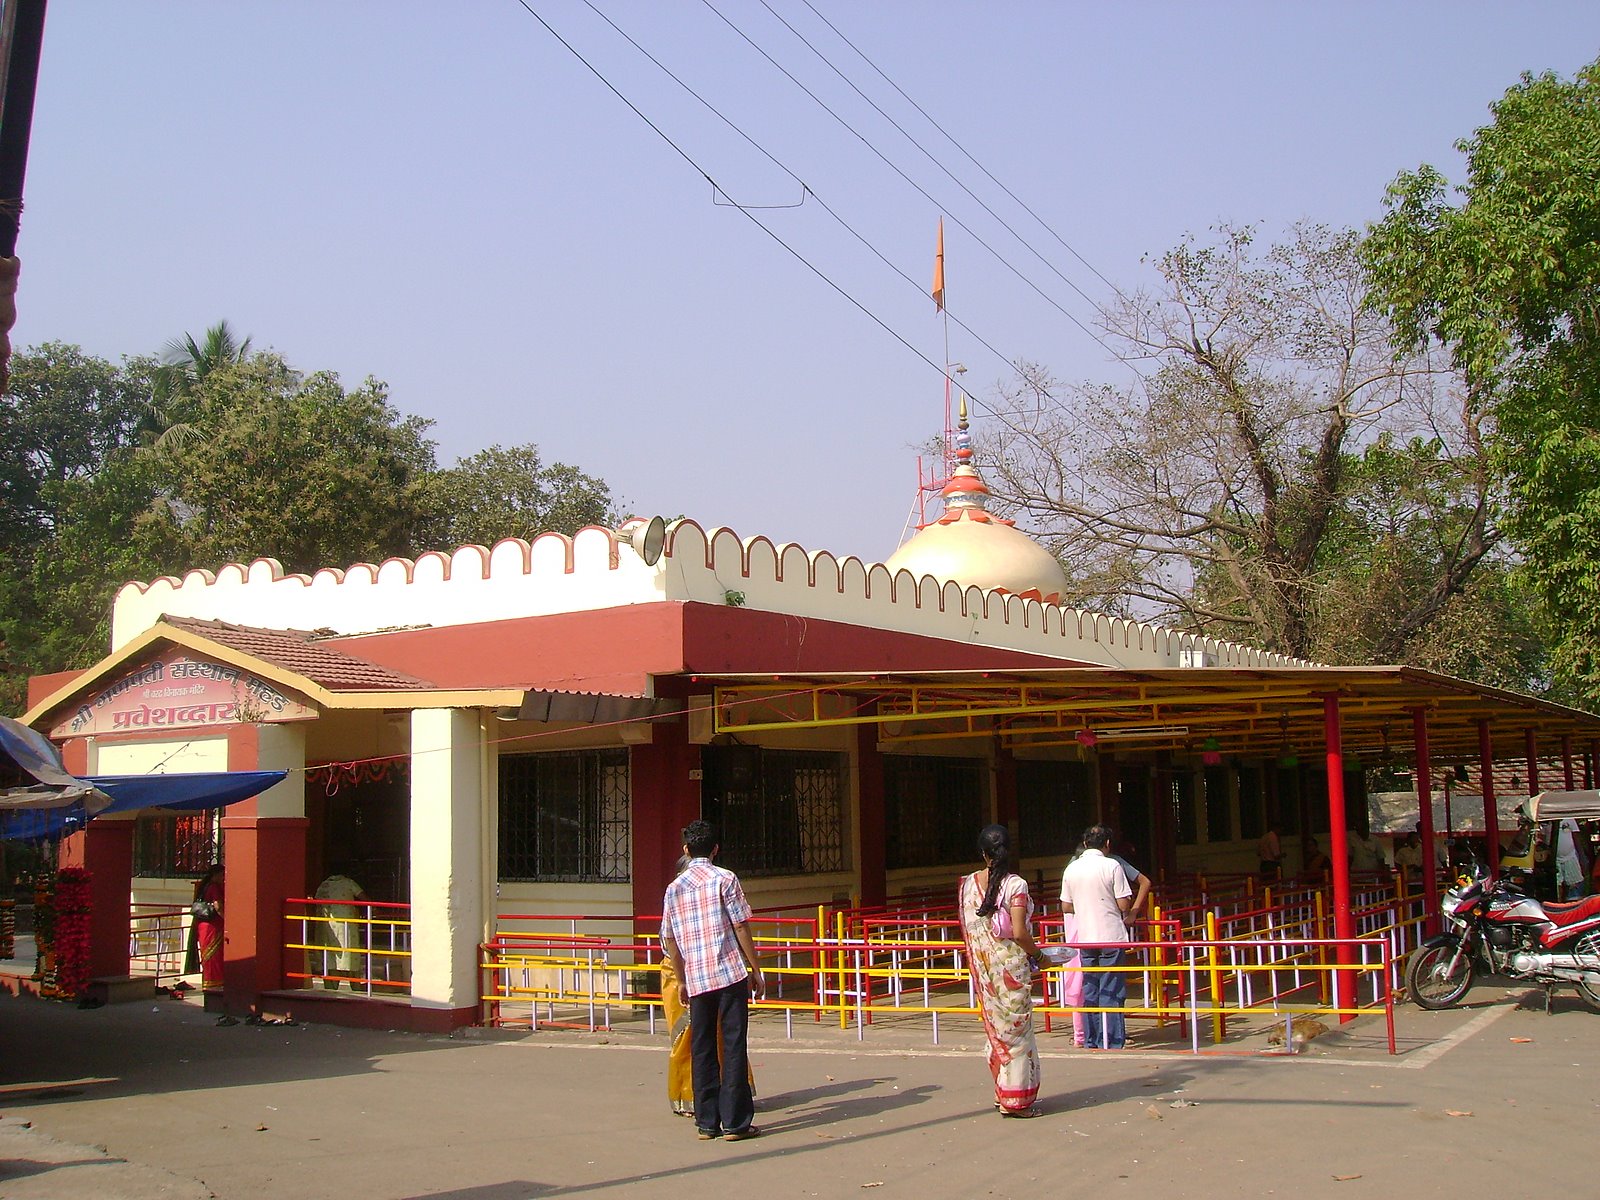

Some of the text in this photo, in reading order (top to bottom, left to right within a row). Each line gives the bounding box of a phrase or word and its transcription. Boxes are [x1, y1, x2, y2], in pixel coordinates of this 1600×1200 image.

[71, 657, 290, 732] श्री गणपती संस्थान महड
